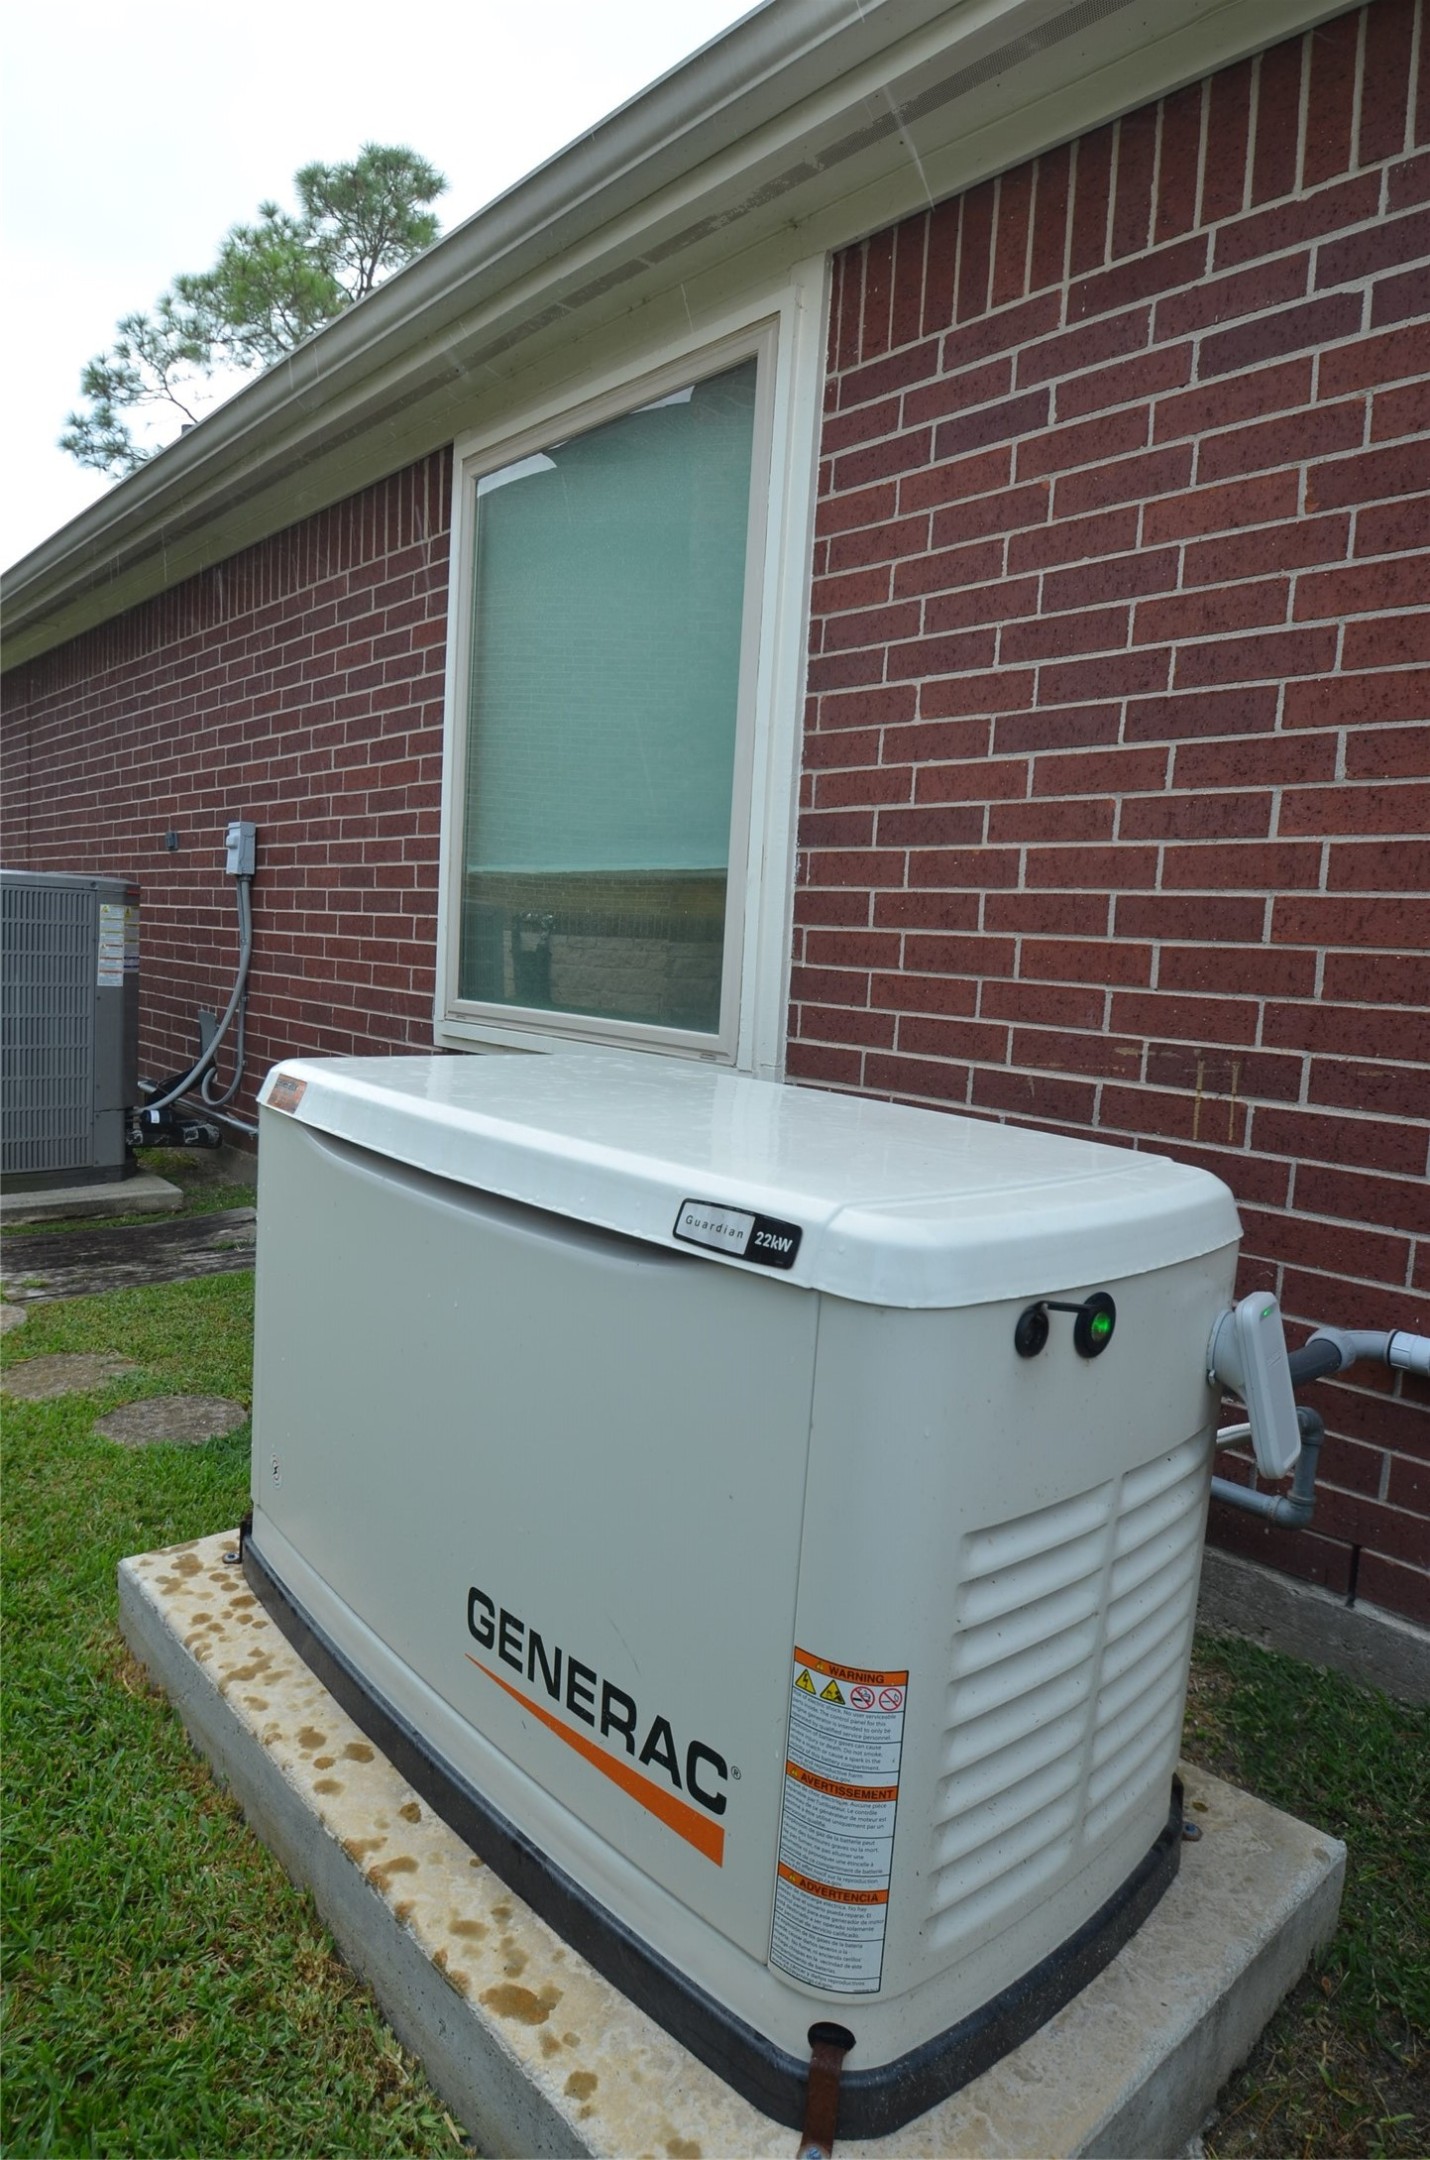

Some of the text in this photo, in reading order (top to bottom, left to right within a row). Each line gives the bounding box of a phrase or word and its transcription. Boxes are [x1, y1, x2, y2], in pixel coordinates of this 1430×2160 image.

[685, 1214, 793, 1253] Guardian 22kW
[828, 1665, 884, 1684] WARNING
[467, 1586, 728, 1816] GENERAC
[800, 1775, 894, 1800] AVERTISSEMENT
[799, 1879, 879, 1903] ADVERTENCIA
